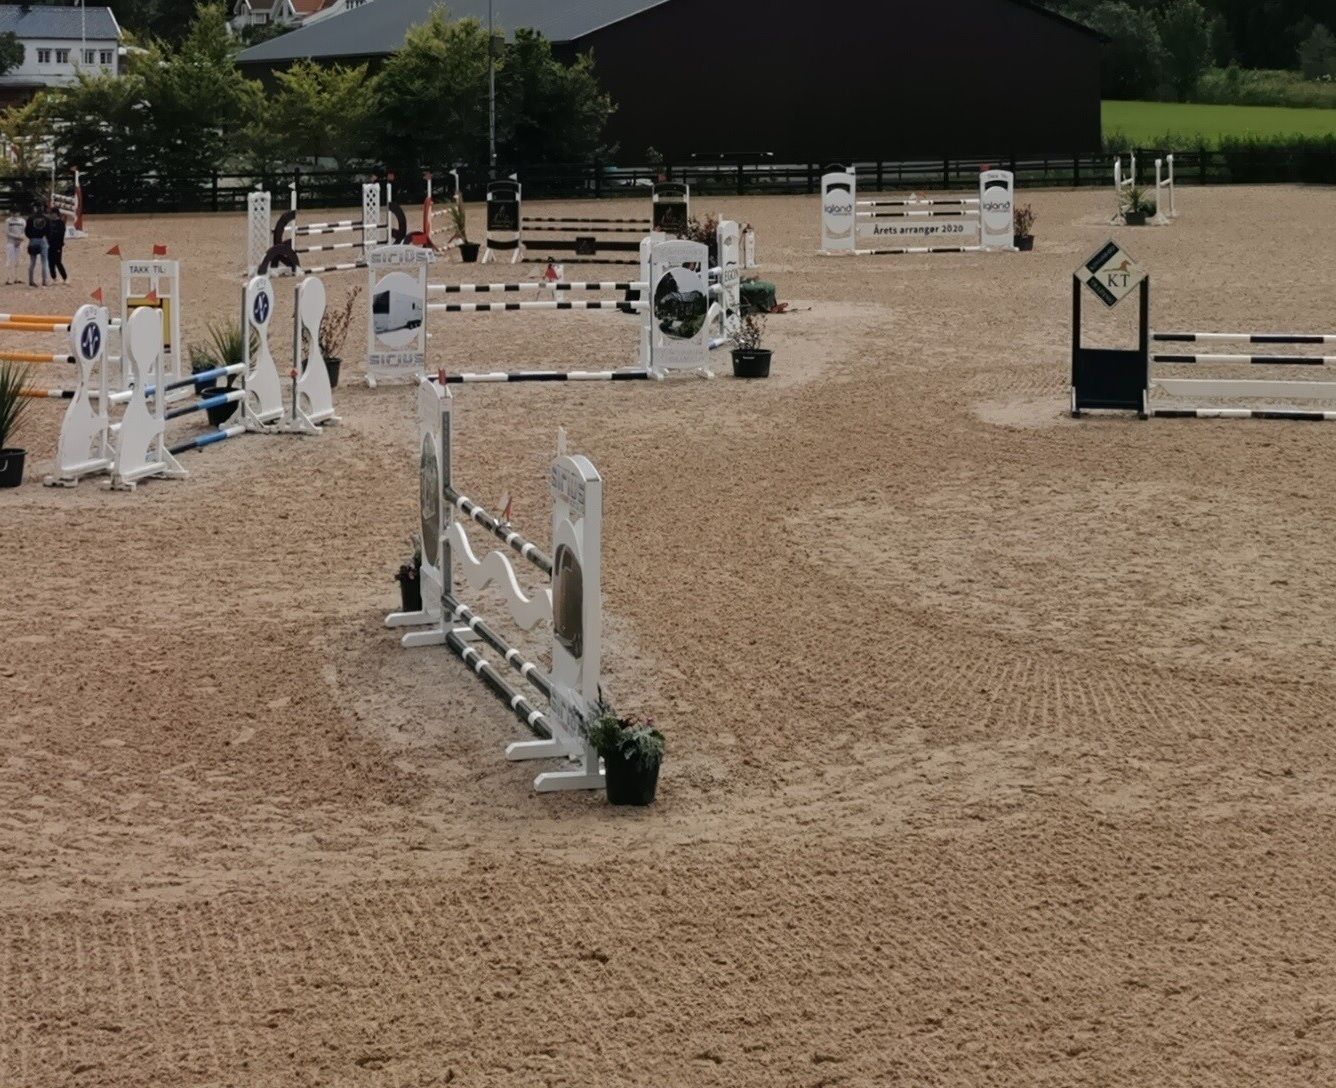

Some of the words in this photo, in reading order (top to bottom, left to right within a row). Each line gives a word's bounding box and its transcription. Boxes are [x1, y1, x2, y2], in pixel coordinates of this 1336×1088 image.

[873, 223, 897, 235] Årets
[899, 225, 939, 236] arrangør
[129, 265, 150, 274] TAKK
